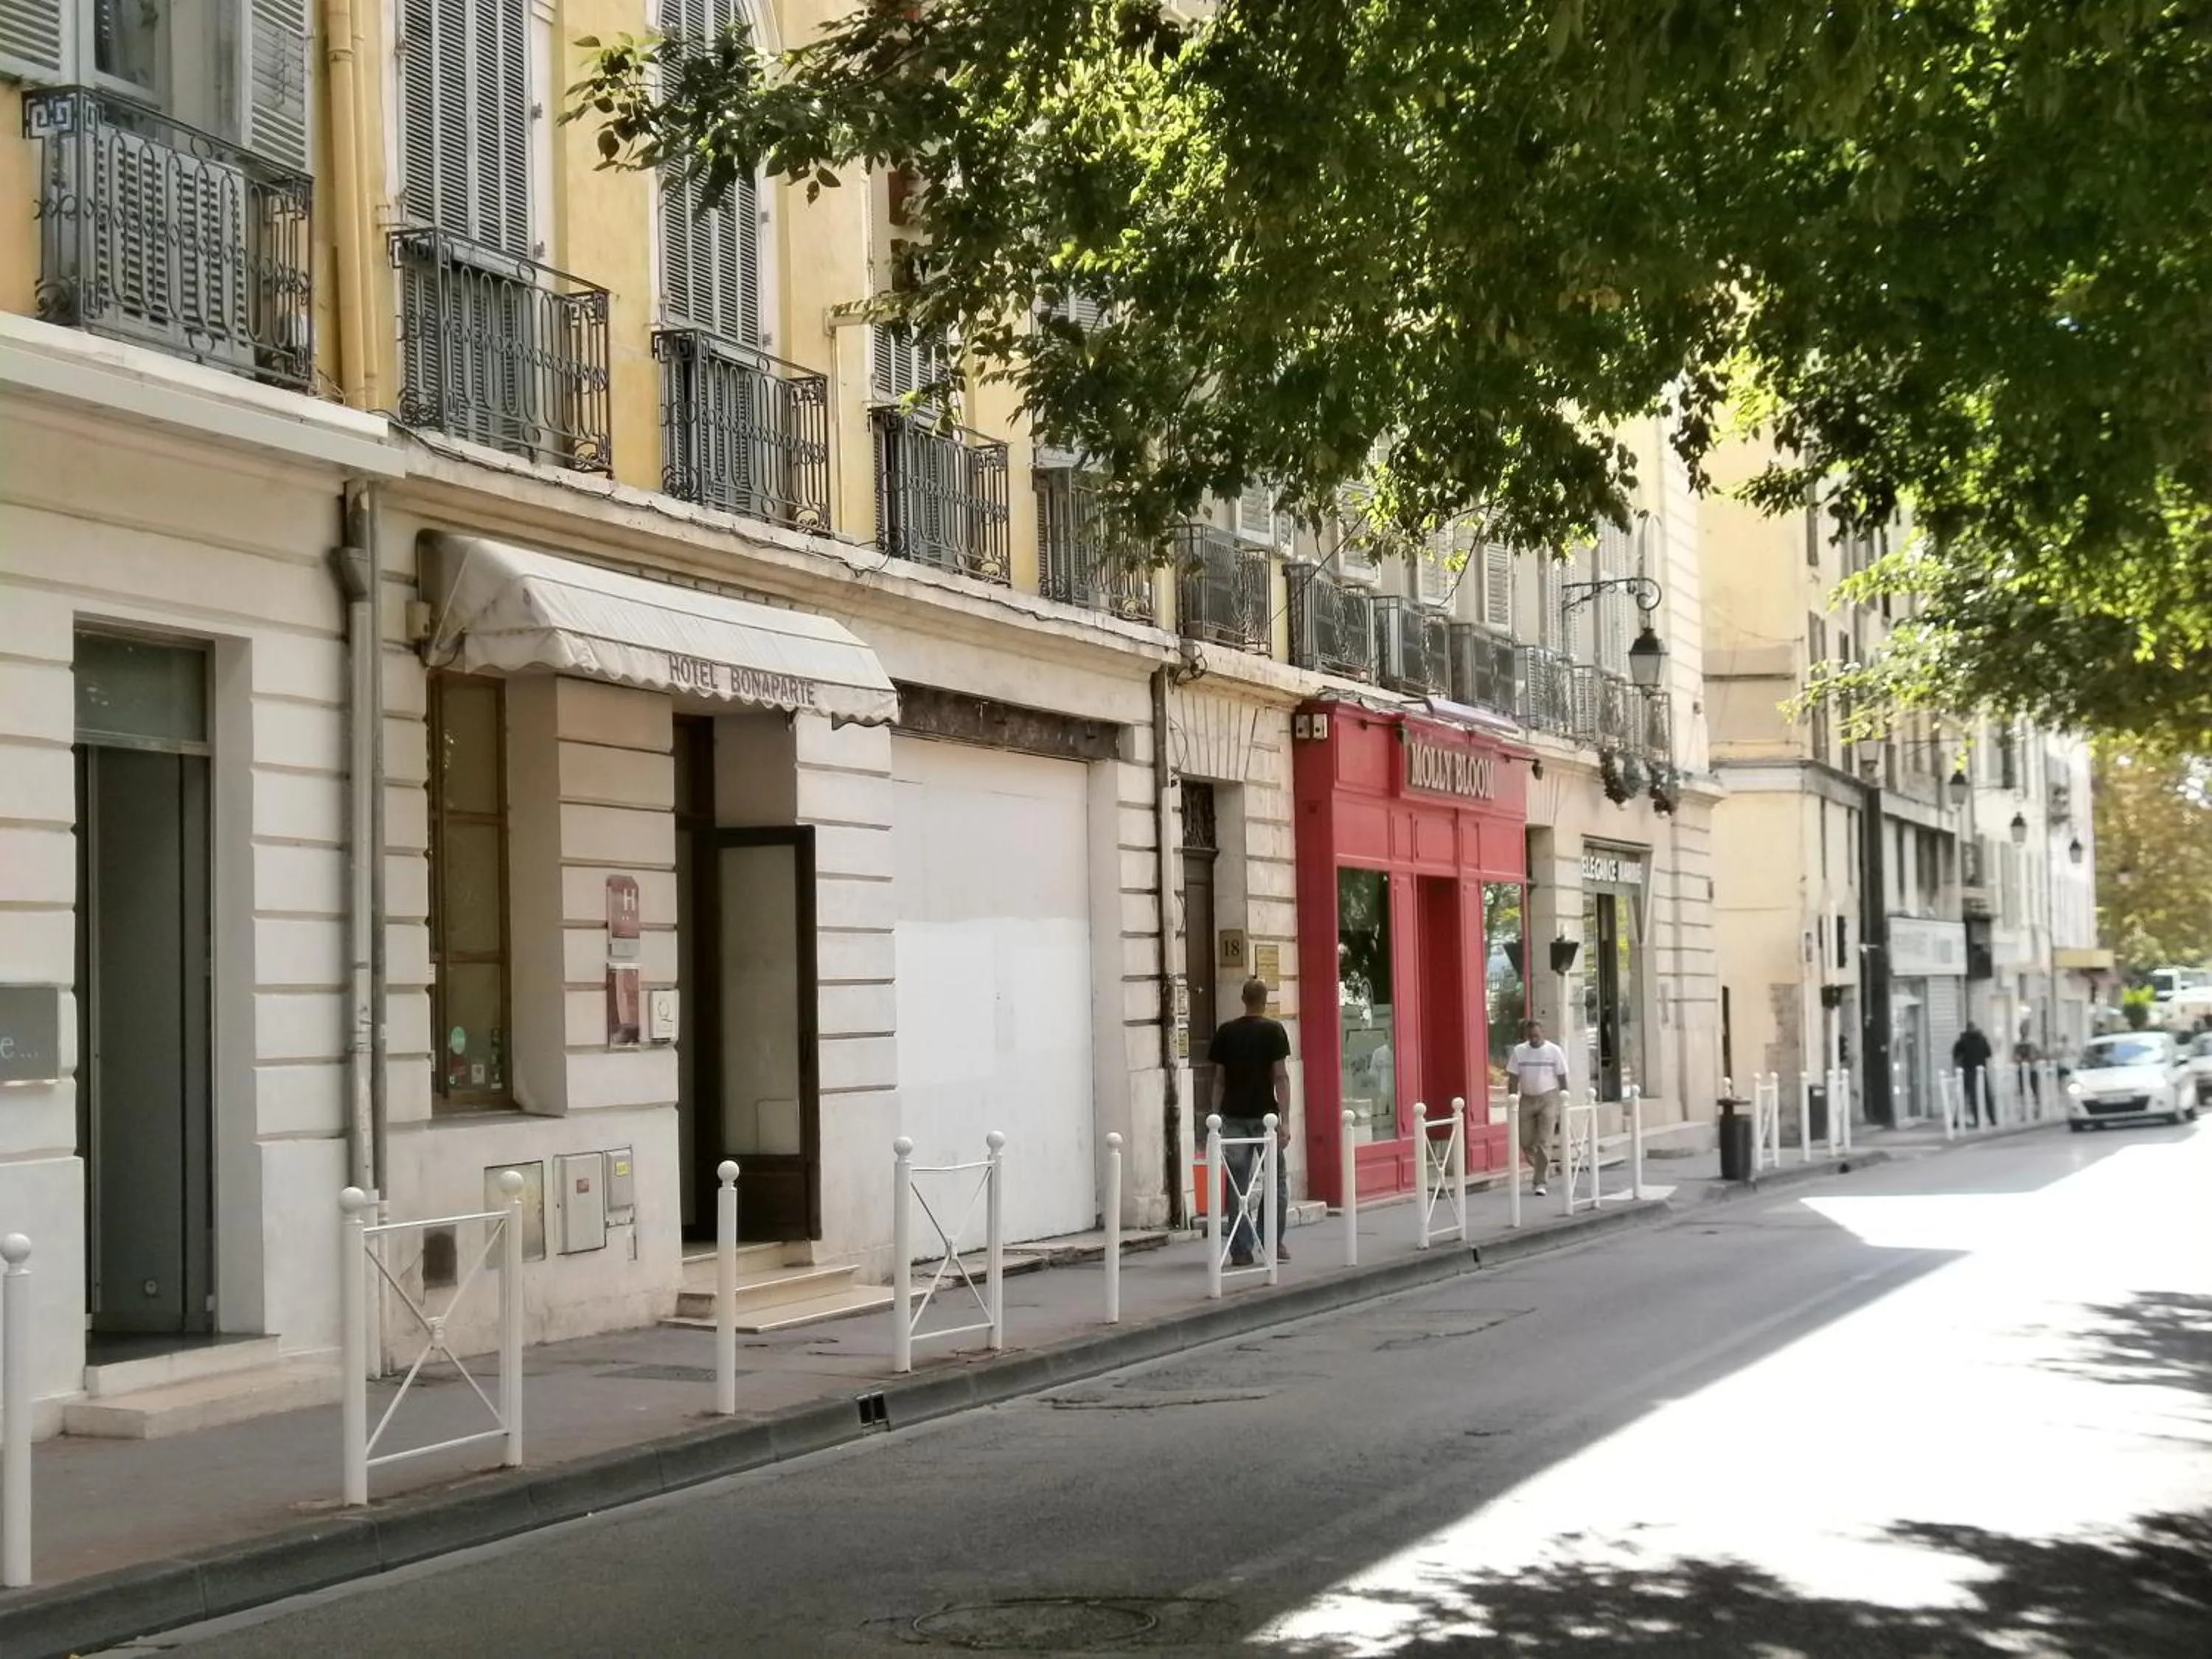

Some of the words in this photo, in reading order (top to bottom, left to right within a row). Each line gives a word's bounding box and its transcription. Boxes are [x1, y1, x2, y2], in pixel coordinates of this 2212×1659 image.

[668, 654, 718, 689] HOTEL
[731, 667, 815, 705] BONAPARTE
[1411, 742, 1451, 790] MOLLY
[1455, 753, 1495, 799] BLOOM
[1223, 939, 1240, 957] 18
